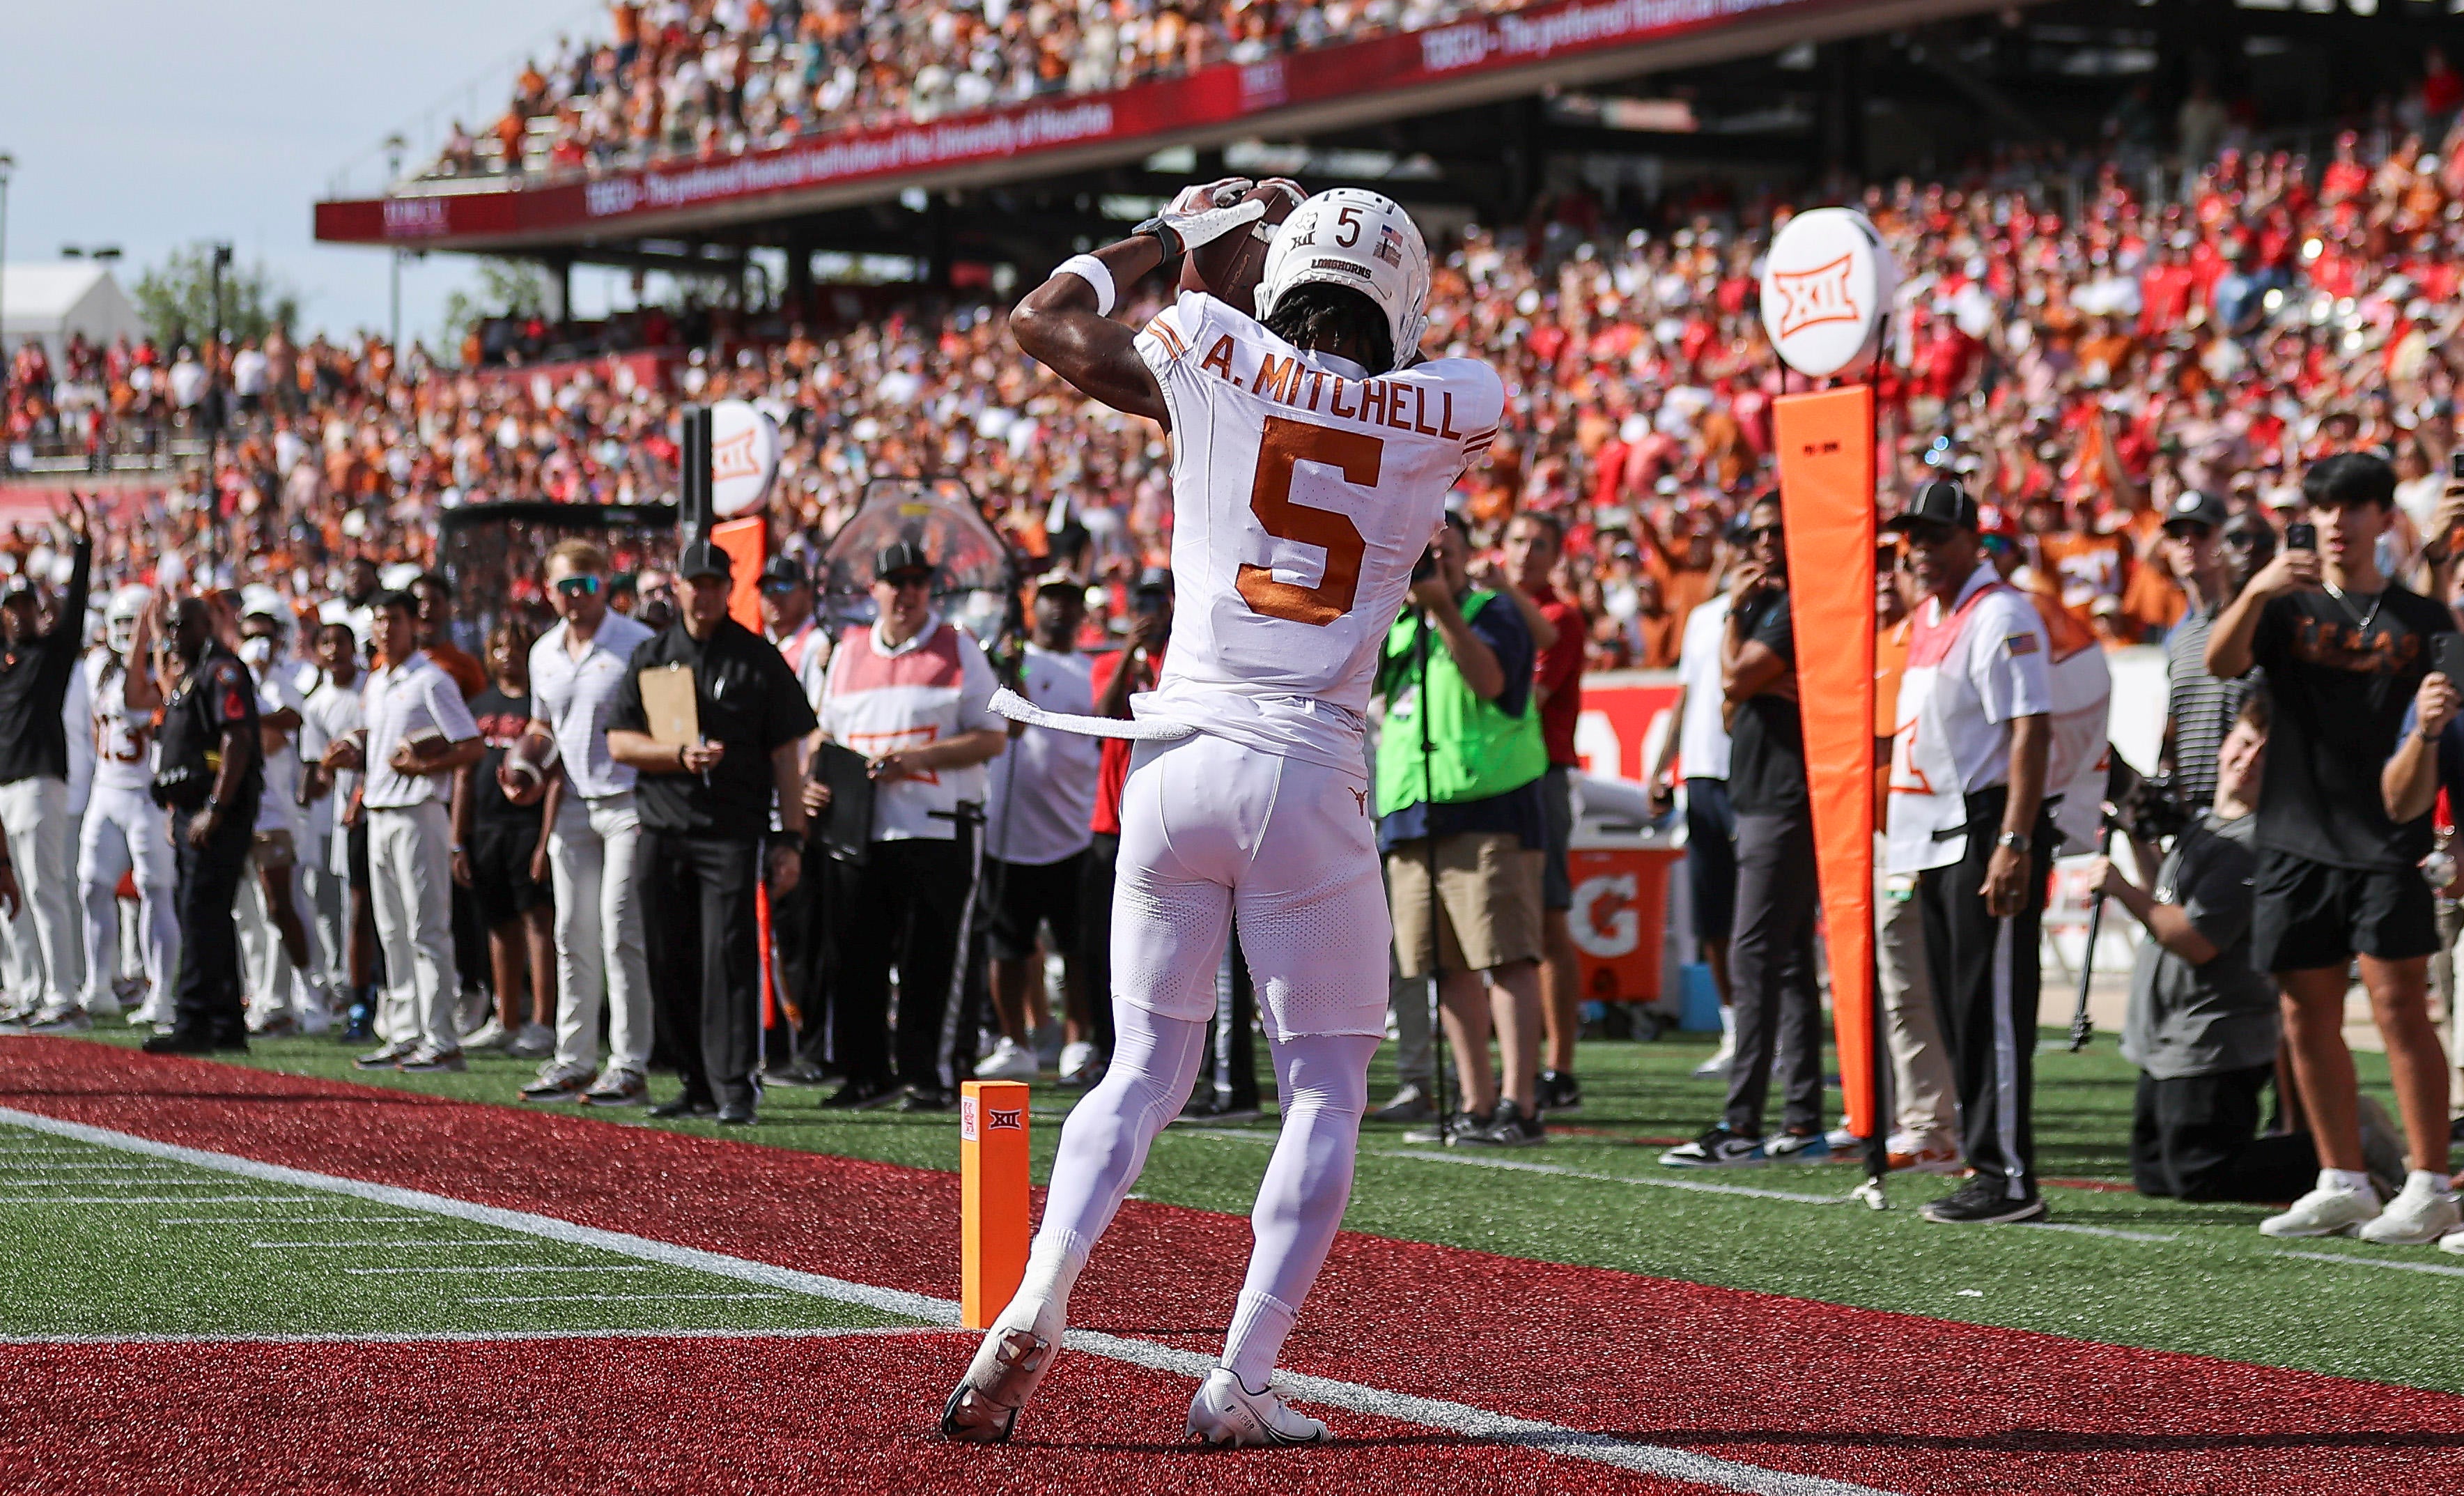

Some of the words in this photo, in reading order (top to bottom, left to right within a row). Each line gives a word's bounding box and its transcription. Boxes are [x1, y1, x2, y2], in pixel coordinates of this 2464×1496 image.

[1310, 259, 1372, 279] LONGHORNS
[1335, 207, 1363, 248] 5
[1772, 253, 1859, 339] XII
[1201, 333, 1243, 387] A.
[1251, 352, 1462, 441] MITCHELL
[1234, 414, 1384, 628] 5
[1568, 874, 1640, 958] G
[988, 1109, 1022, 1130] XII
